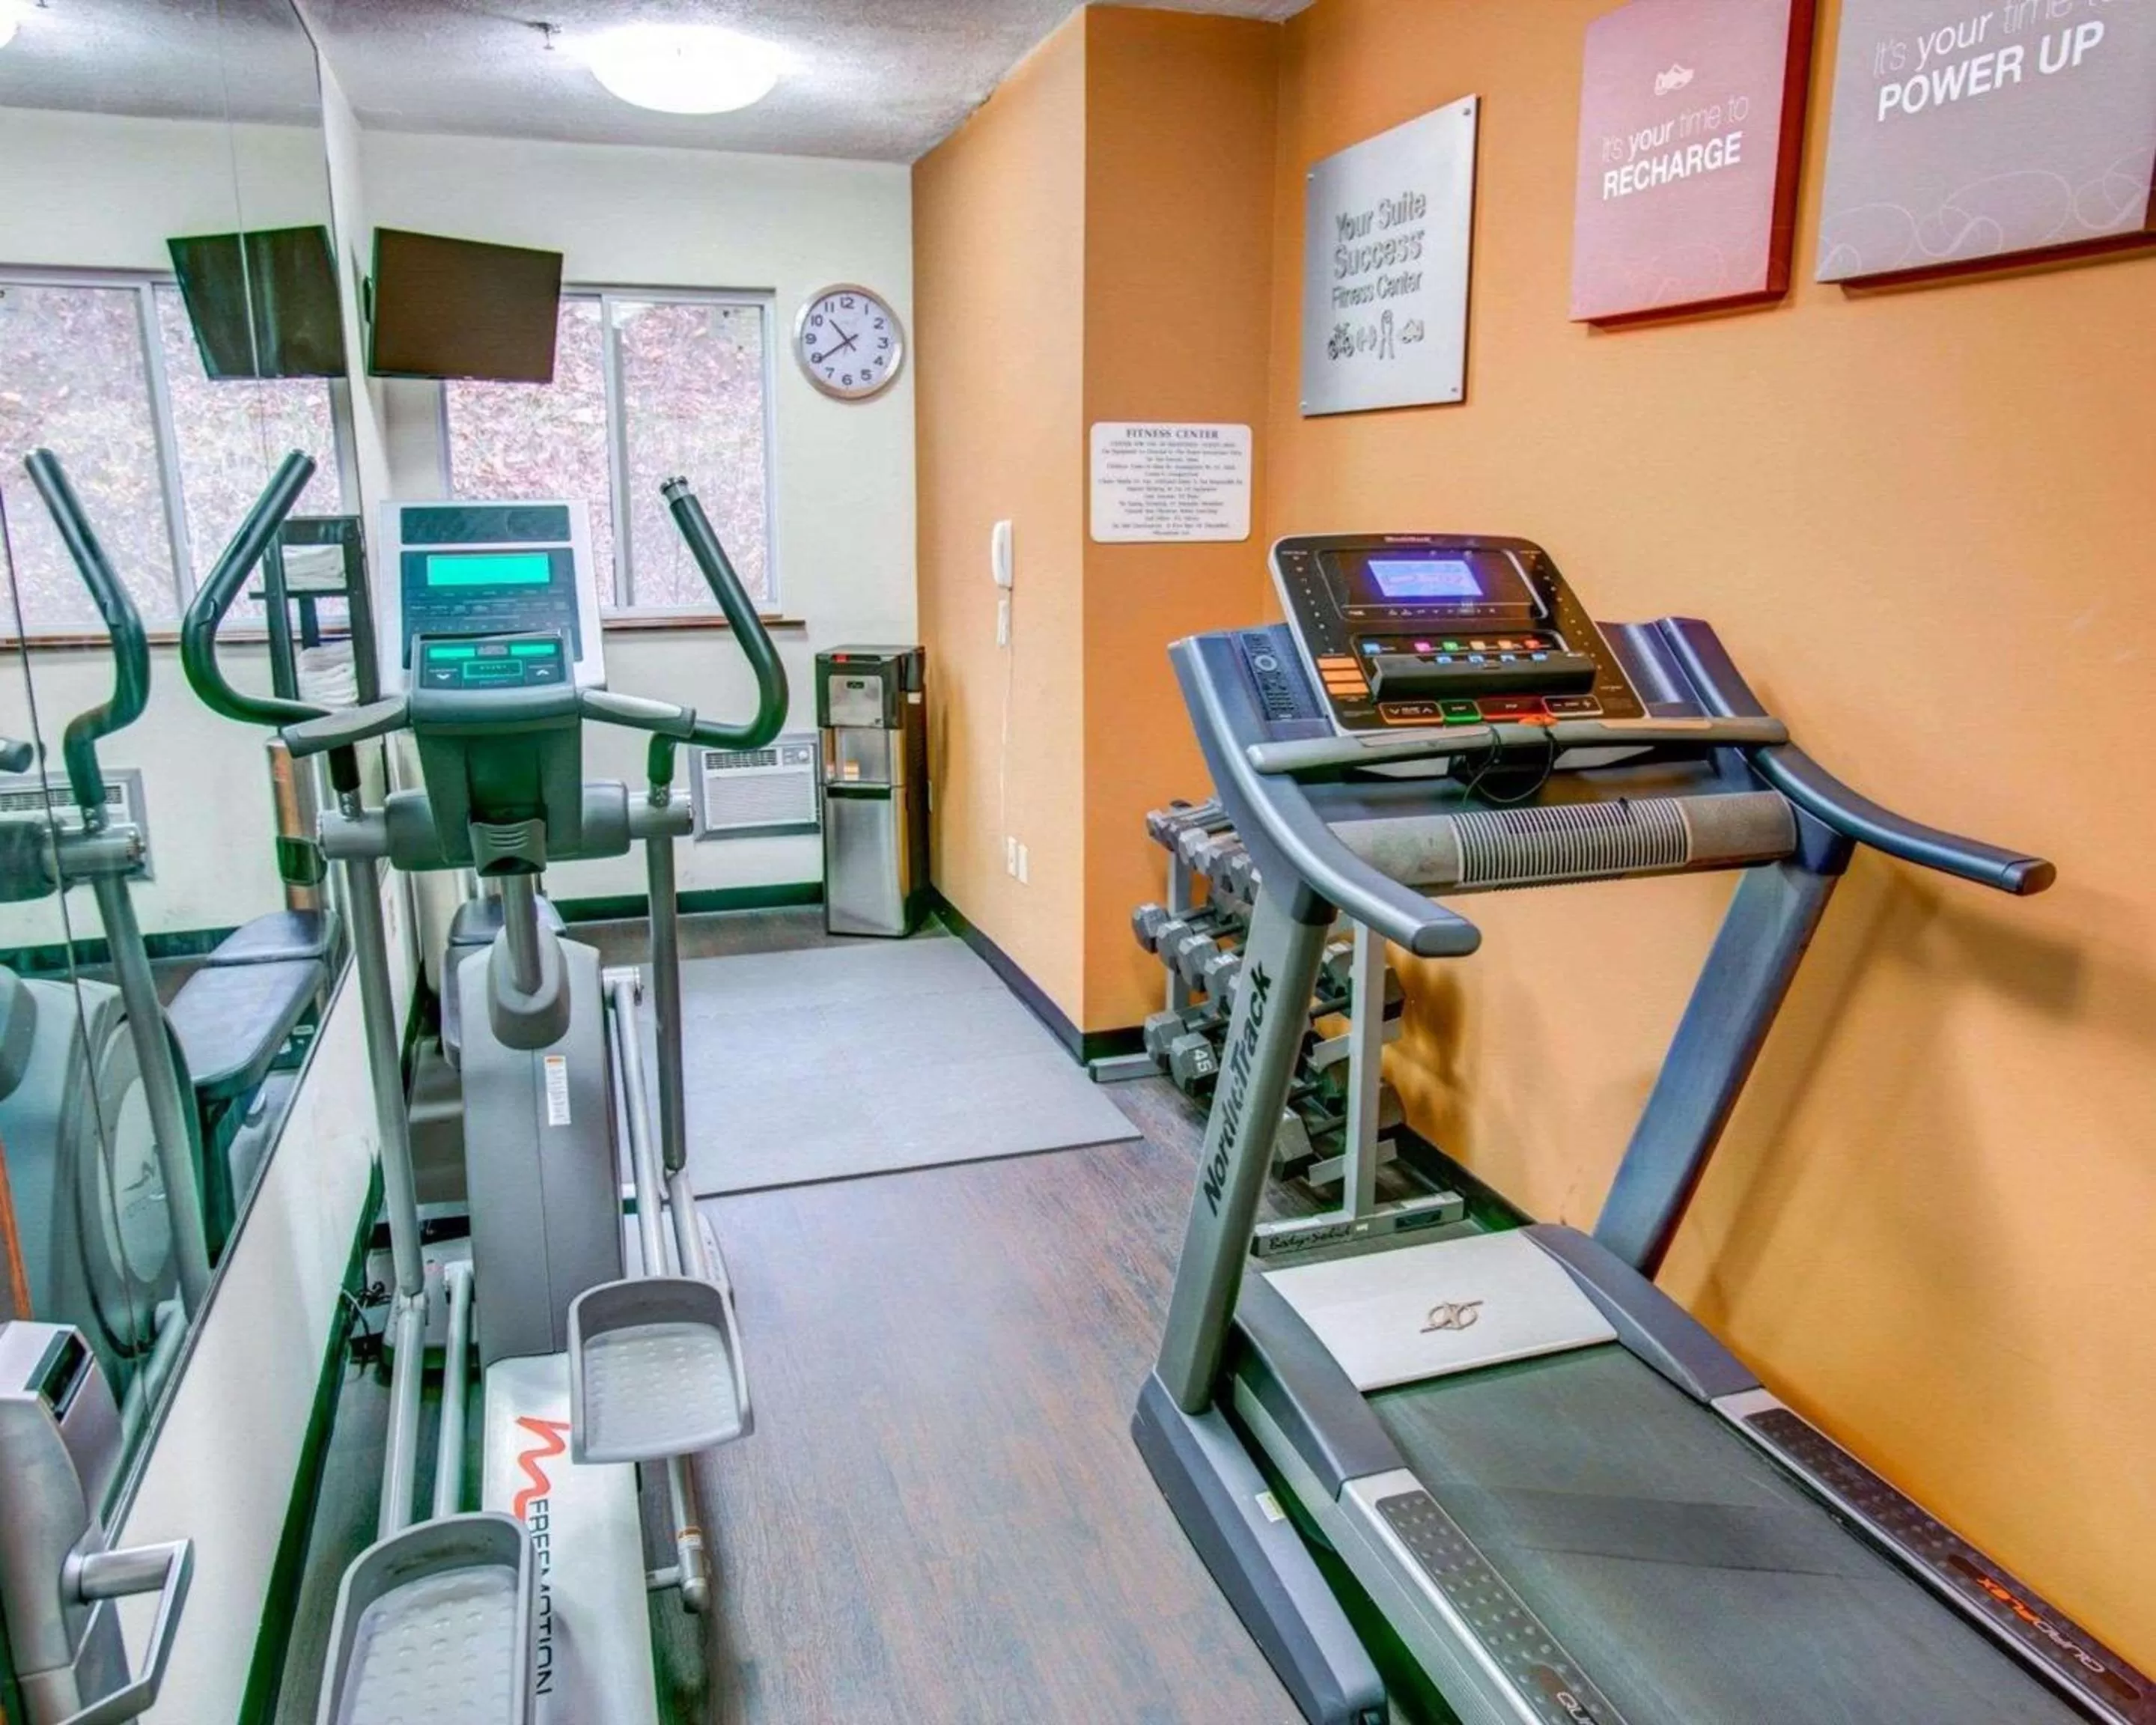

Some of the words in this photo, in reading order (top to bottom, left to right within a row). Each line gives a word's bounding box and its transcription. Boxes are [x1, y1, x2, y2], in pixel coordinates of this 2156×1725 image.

[1914, 11, 1994, 73] your
[1878, 45, 2024, 122] POWER
[2038, 20, 2105, 75] UP
[1627, 120, 1675, 162] your
[1679, 104, 1721, 138] time
[1728, 95, 1750, 124] to
[1603, 130, 1744, 201] RECHARGE
[1335, 210, 1374, 243] Your
[1378, 191, 1427, 229] Suite
[1331, 284, 1375, 311] Fitness
[1377, 270, 1423, 300] Center
[824, 302, 835, 313] 11
[840, 296, 854, 309] 12
[811, 314, 823, 327] 10
[874, 317, 884, 329] 2
[805, 333, 817, 344] 9
[877, 337, 889, 349] 3
[811, 352, 823, 364] 8
[873, 356, 883, 366] 4
[824, 366, 835, 379] 7
[861, 368, 872, 380] 5
[841, 374, 853, 386] 6
[1126, 428, 1172, 439] FITNESS
[1175, 429, 1219, 439] CENTER
[1193, 1048, 1213, 1073] 45
[1203, 961, 1272, 1218] NordicTrack
